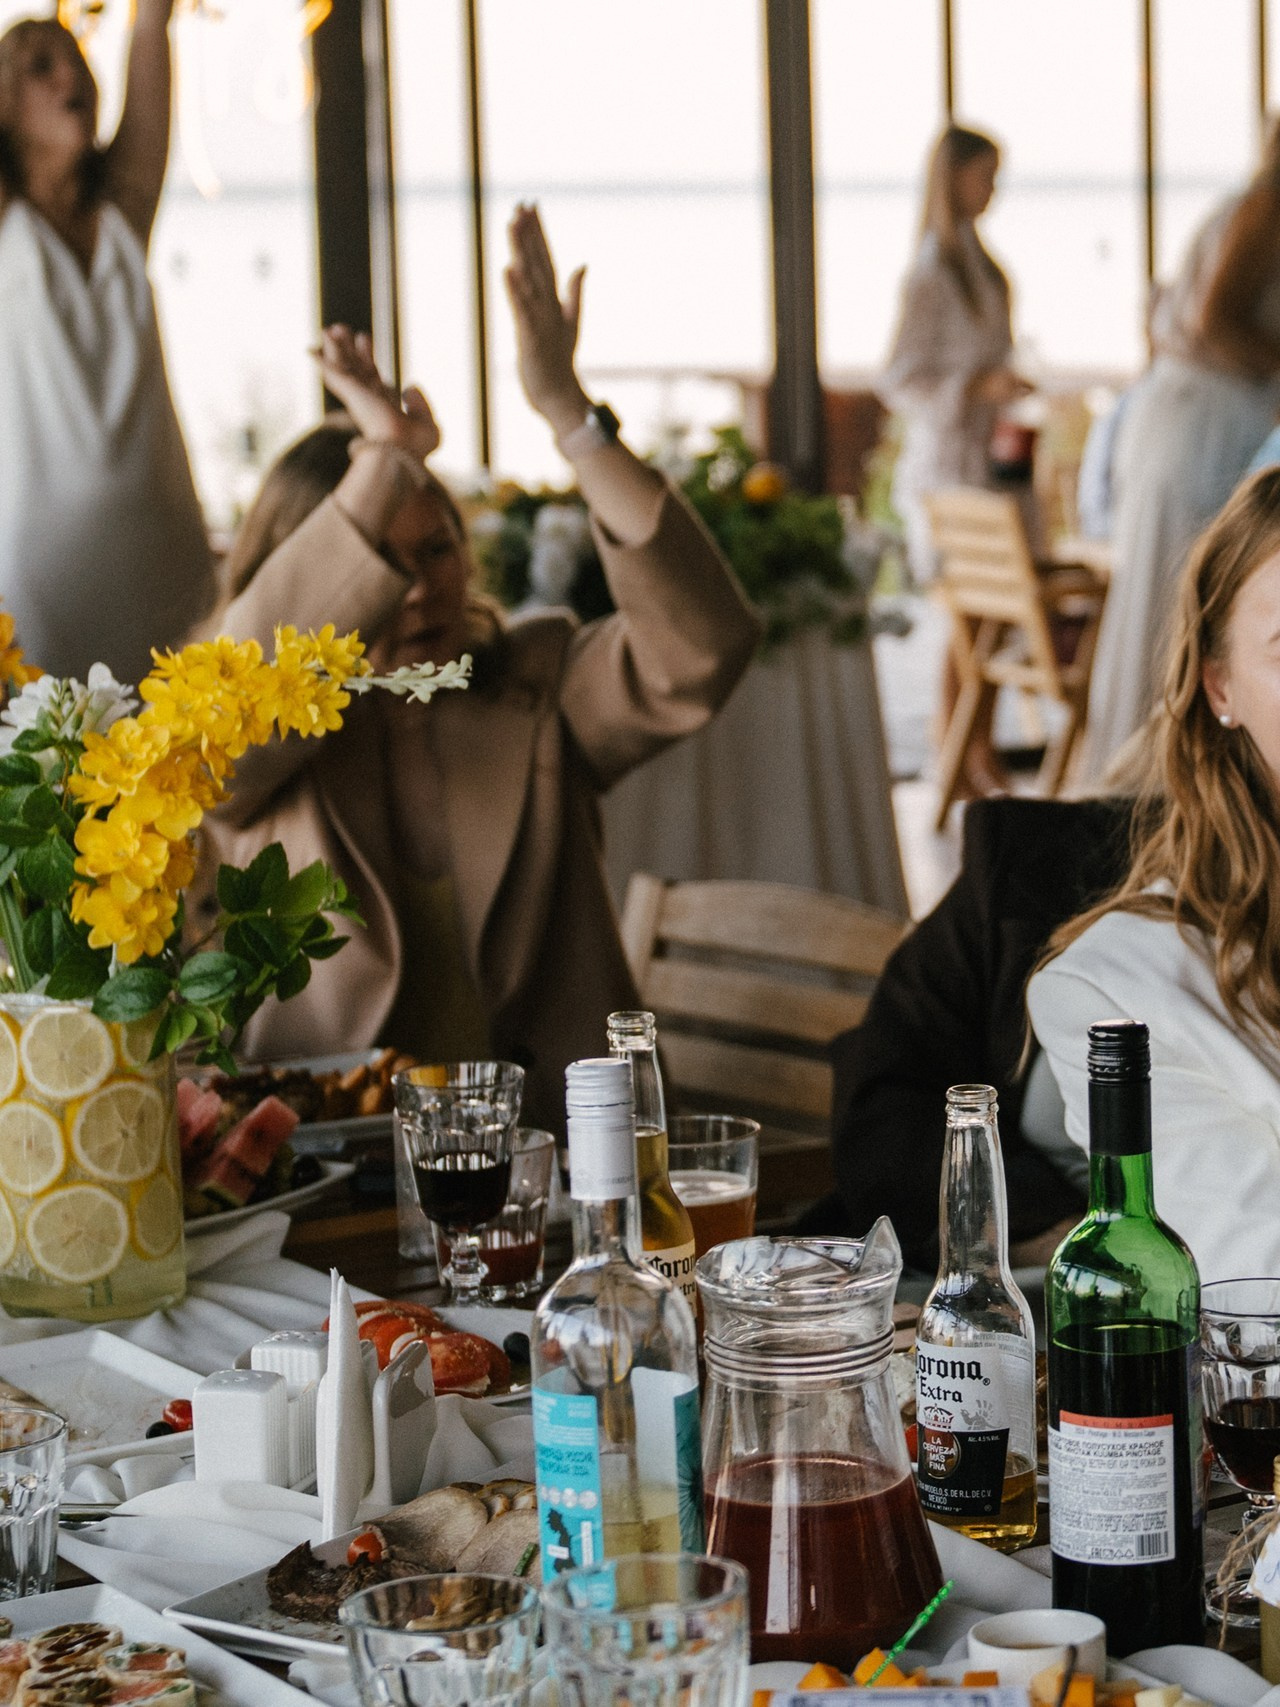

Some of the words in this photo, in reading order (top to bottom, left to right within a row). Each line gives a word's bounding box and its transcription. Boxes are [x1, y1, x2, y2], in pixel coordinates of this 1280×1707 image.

[920, 1375, 963, 1403] Extra
[931, 1436, 942, 1445] LA
[1129, 1440, 1164, 1450] КРАСНОЕ
[922, 1441, 956, 1456] CERVEZA
[1125, 1449, 1161, 1457] PINOTAGE
[928, 1461, 946, 1472] FINA
